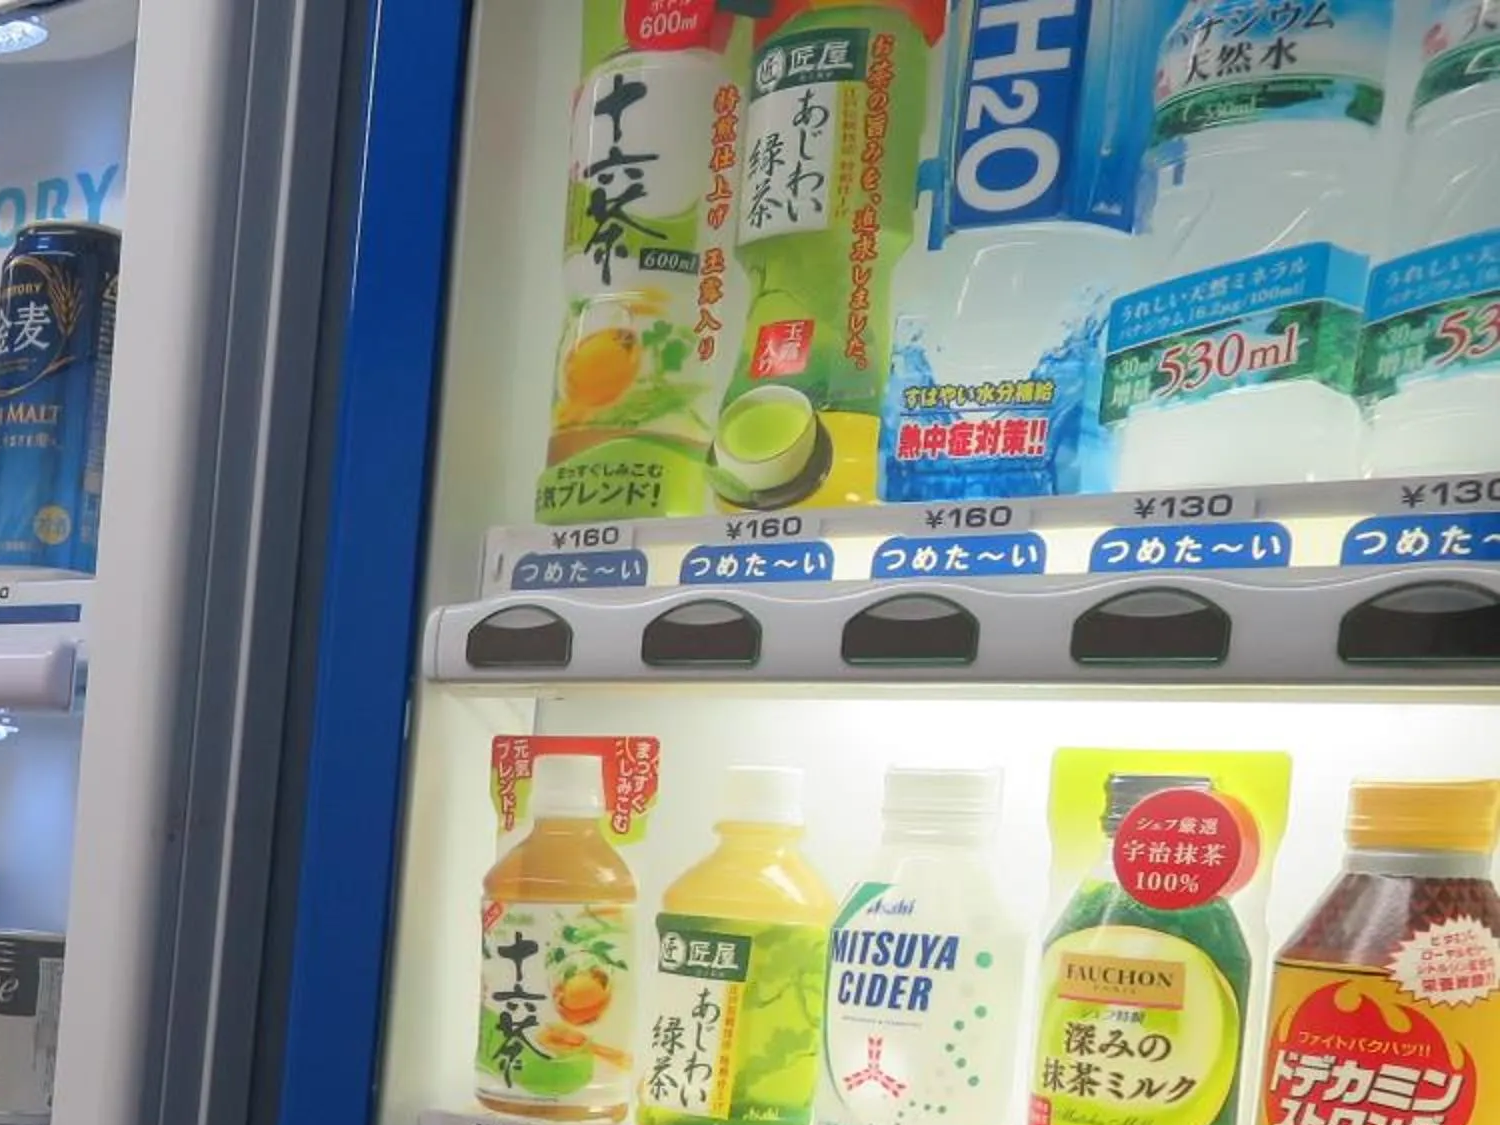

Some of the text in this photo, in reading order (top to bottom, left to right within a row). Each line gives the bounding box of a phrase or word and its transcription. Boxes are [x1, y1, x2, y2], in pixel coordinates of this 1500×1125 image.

[639, 10, 698, 39] 600ml
[1182, 36, 1299, 84] 天然水
[956, 0, 1077, 212] H2O
[786, 88, 831, 222] あじわい
[584, 73, 668, 287] 十六茶
[1155, 321, 1299, 397] 530ml
[725, 515, 802, 540] ¥160
[925, 505, 1012, 529] ¥160
[1133, 493, 1234, 520] ¥130
[552, 526, 620, 550] ¥160
[1122, 839, 1228, 867] 宇治抹茶
[1135, 871, 1200, 894] 100%
[831, 928, 961, 971] MITSUYA
[836, 969, 934, 1012] CIDER
[1066, 962, 1174, 988] FAUCHON
[492, 931, 552, 1090] 十六茶
[649, 1014, 687, 1101] 緑茶
[679, 987, 722, 1108] あじわい
[1063, 1021, 1173, 1063] 深みの
[1042, 1056, 1199, 1105] 抹茶ミルク
[1269, 1049, 1465, 1114] ドデカミン
